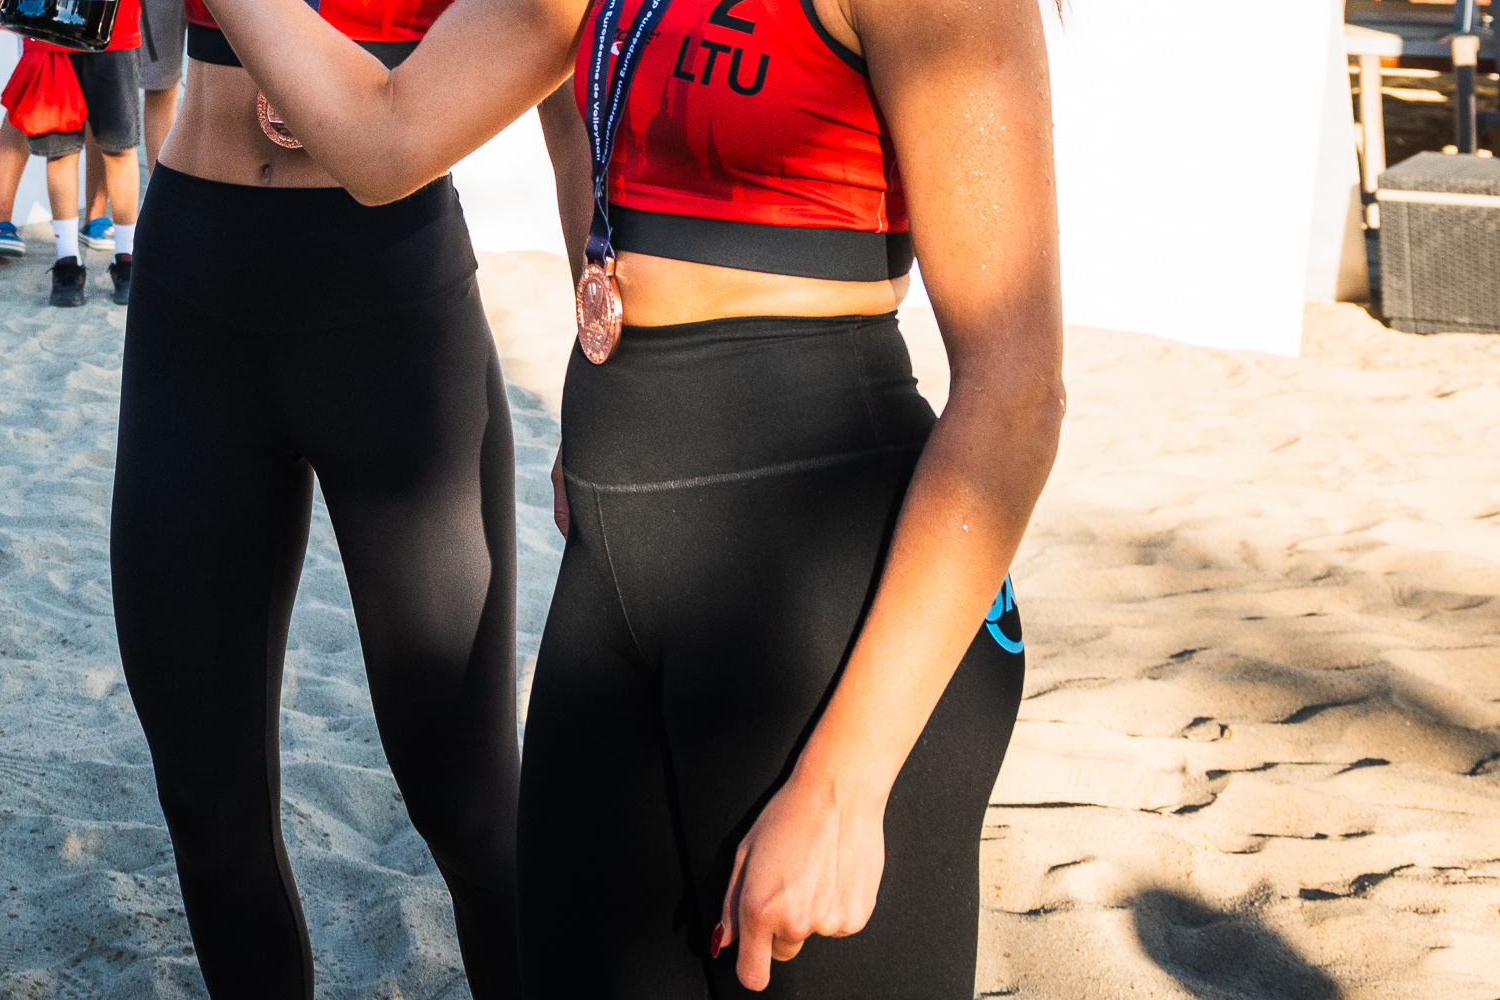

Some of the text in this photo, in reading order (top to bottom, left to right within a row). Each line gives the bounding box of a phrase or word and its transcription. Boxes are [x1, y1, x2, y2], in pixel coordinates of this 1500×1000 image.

[593, 83, 599, 98] de
[672, 35, 770, 96] LTU
[592, 102, 601, 160] Volleyball
